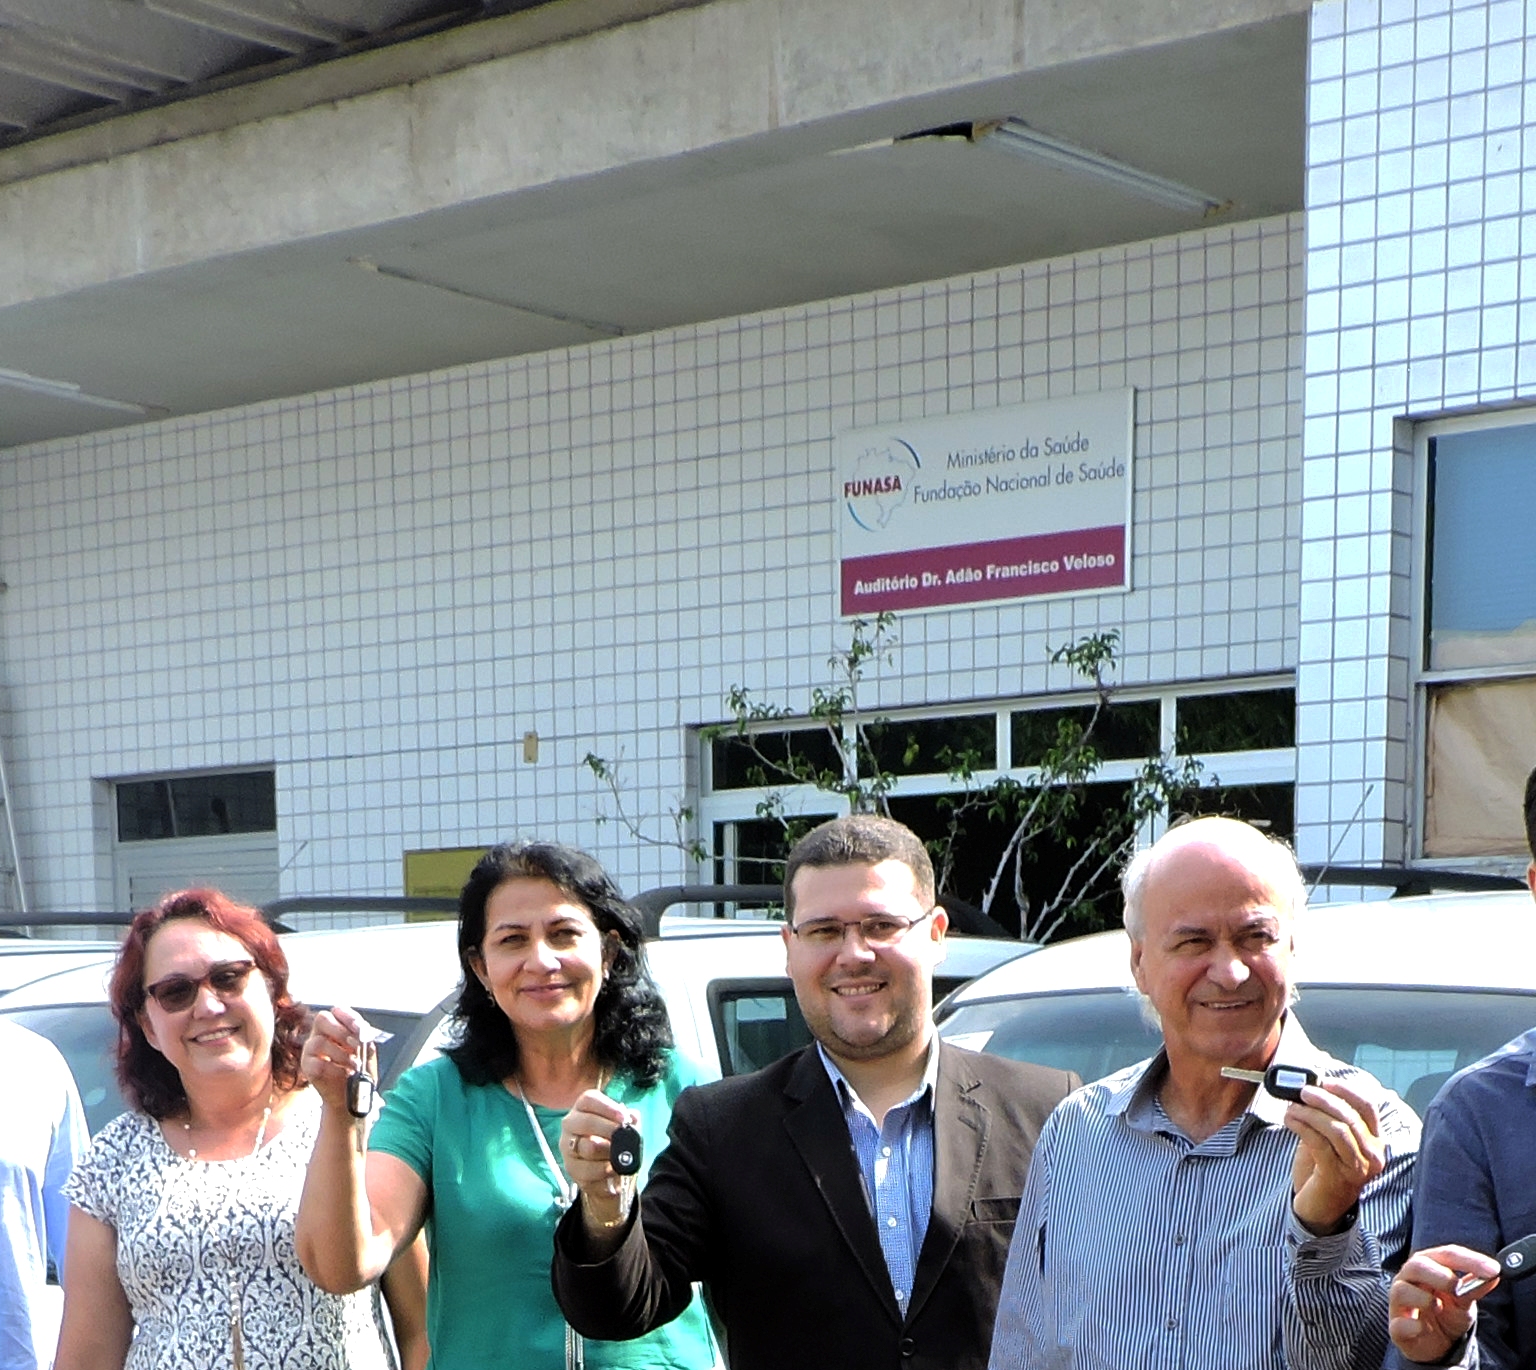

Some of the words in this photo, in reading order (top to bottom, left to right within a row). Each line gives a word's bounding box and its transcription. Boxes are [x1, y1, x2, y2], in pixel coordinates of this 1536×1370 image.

[947, 444, 1016, 469] Ministério
[1020, 437, 1039, 460] da
[1044, 430, 1090, 457] Saúde
[844, 475, 903, 499] FUNASA
[914, 479, 982, 504] Fundação
[986, 464, 1051, 494] Nacional
[1055, 463, 1074, 486] de
[1078, 456, 1125, 482] Saúde
[854, 574, 918, 595] Auditório
[922, 572, 942, 587] Dr.
[945, 567, 983, 585] Adão
[986, 560, 1059, 580] Francisco
[1063, 553, 1115, 571] Veloso
